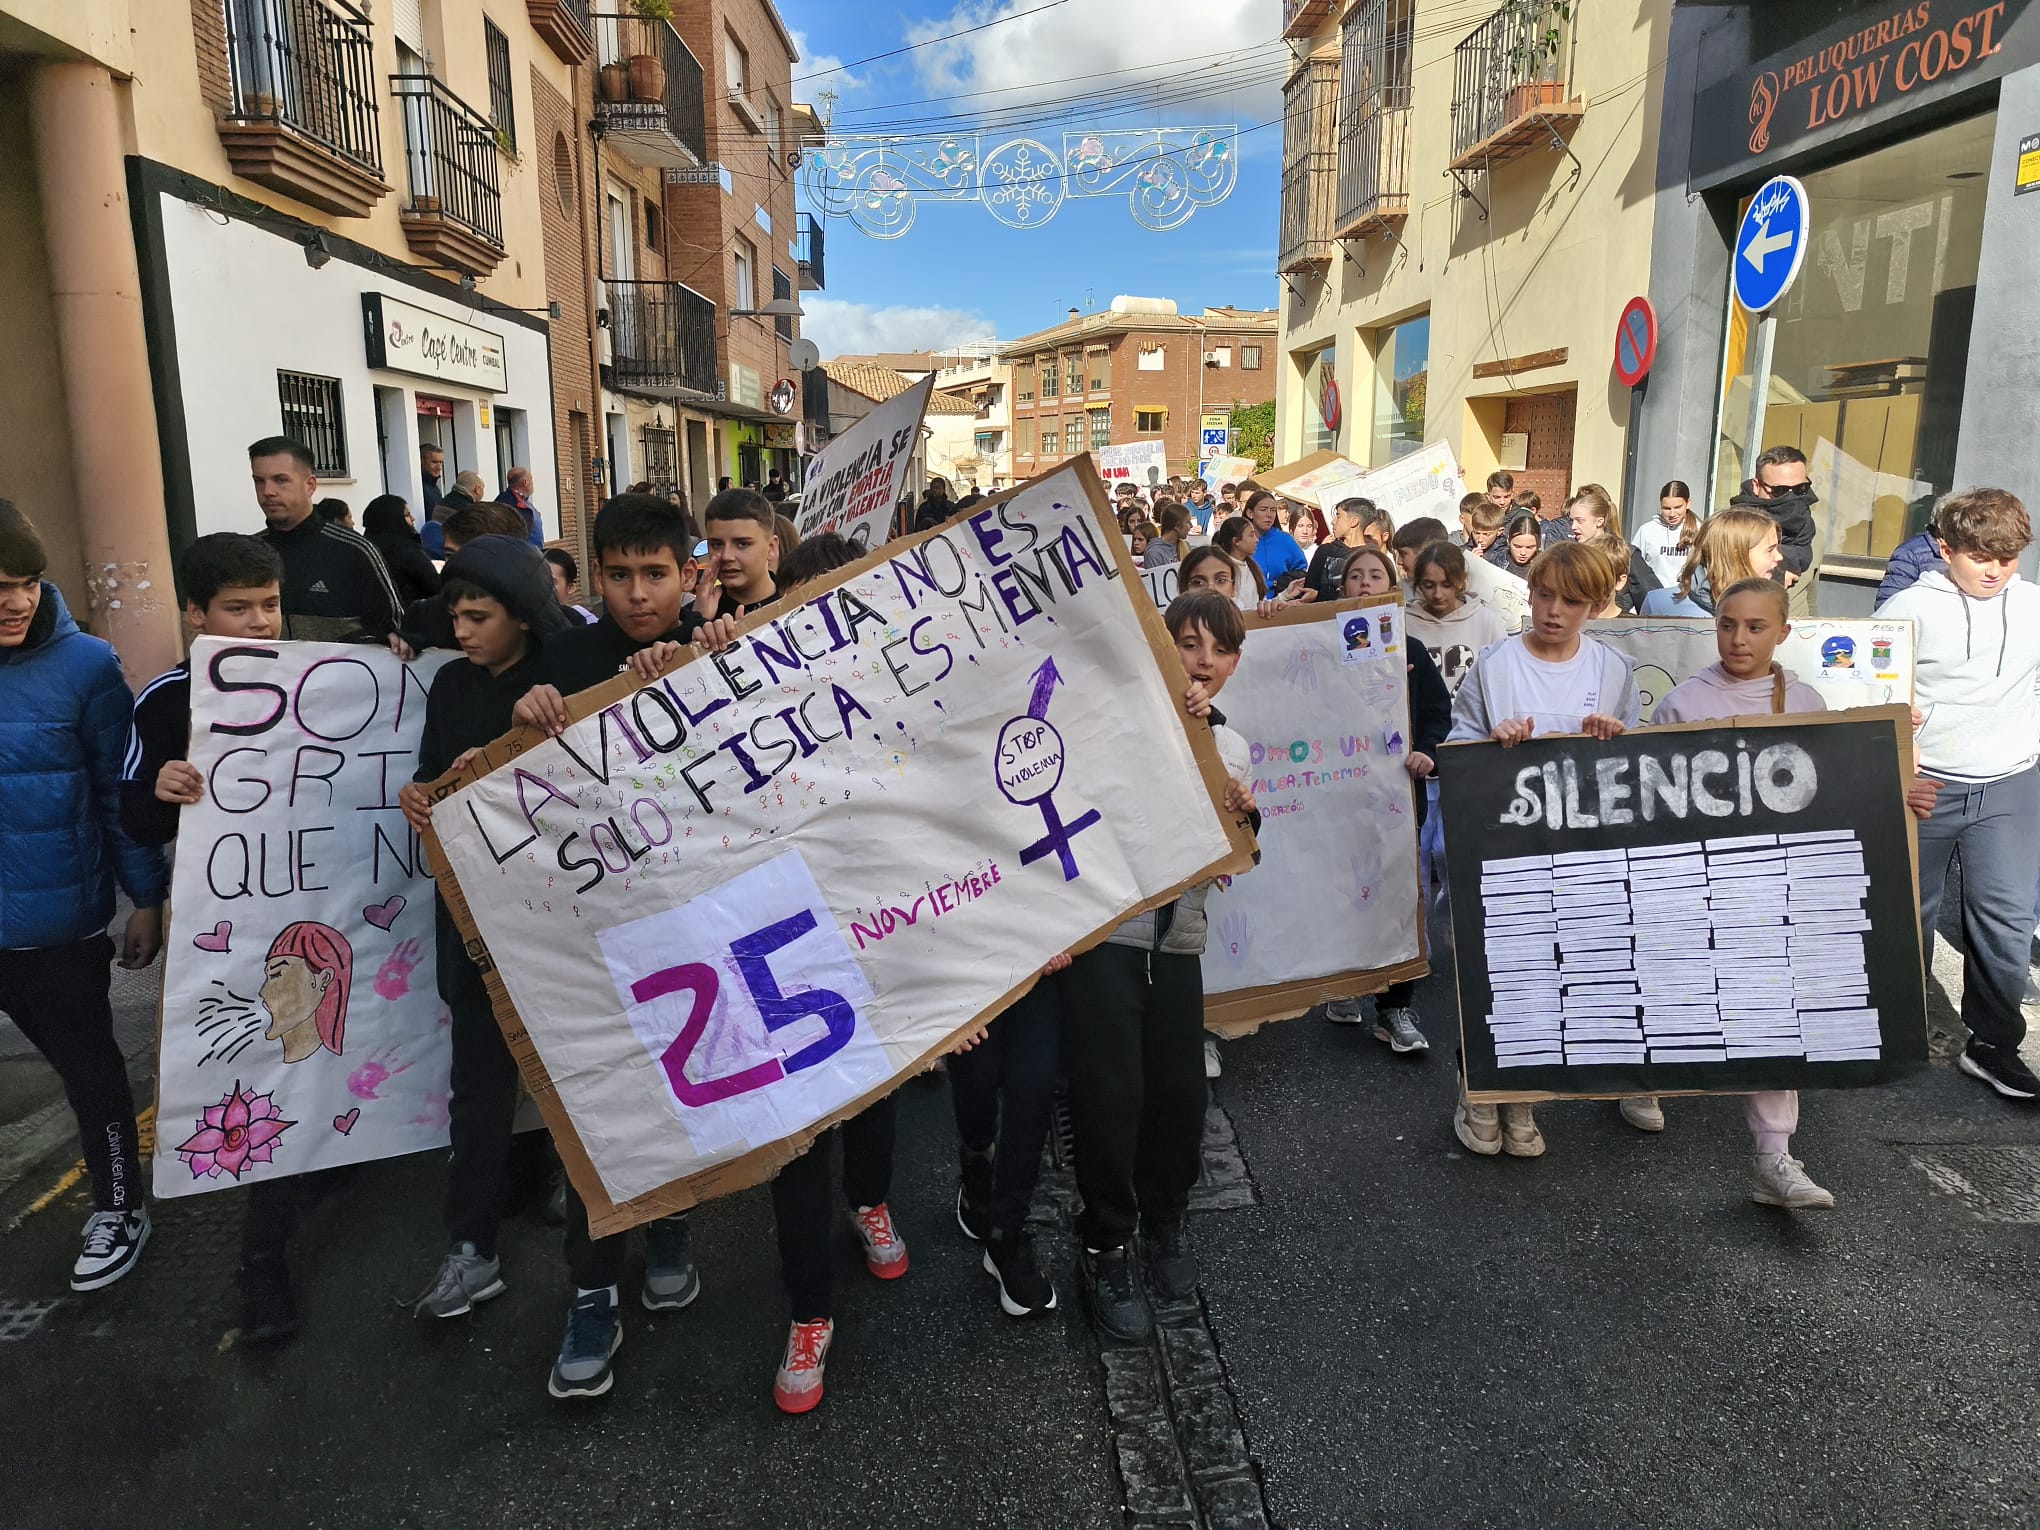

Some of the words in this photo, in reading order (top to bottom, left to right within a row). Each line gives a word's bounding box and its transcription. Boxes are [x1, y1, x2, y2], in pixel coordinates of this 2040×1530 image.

[1782, 0, 1931, 91] PELUQUERIAS
[1807, 54, 1889, 129] LOW
[1895, 2, 2005, 92] COST
[422, 326, 447, 370] Café
[450, 334, 477, 368] Centro
[801, 488, 818, 515] LA
[820, 438, 883, 503] VIOLENCIA
[888, 425, 912, 459] SE
[827, 491, 847, 518] CON
[466, 767, 580, 865] LA
[555, 587, 888, 786] VIOLENCIA
[889, 534, 967, 609] NO
[967, 494, 1038, 567] ES
[556, 797, 673, 895] SOLO
[680, 683, 872, 814] FISICA
[881, 615, 954, 697] ES
[959, 515, 1120, 649] MENTAL
[1001, 726, 1046, 765] STOP
[1003, 753, 1063, 788] VIOLENCIA
[1339, 735, 1370, 757] UN
[1500, 738, 1817, 830] SILENCIO
[207, 826, 335, 900] QUE
[850, 861, 1002, 950] NOVIEMBRE
[630, 908, 856, 1108] 25
